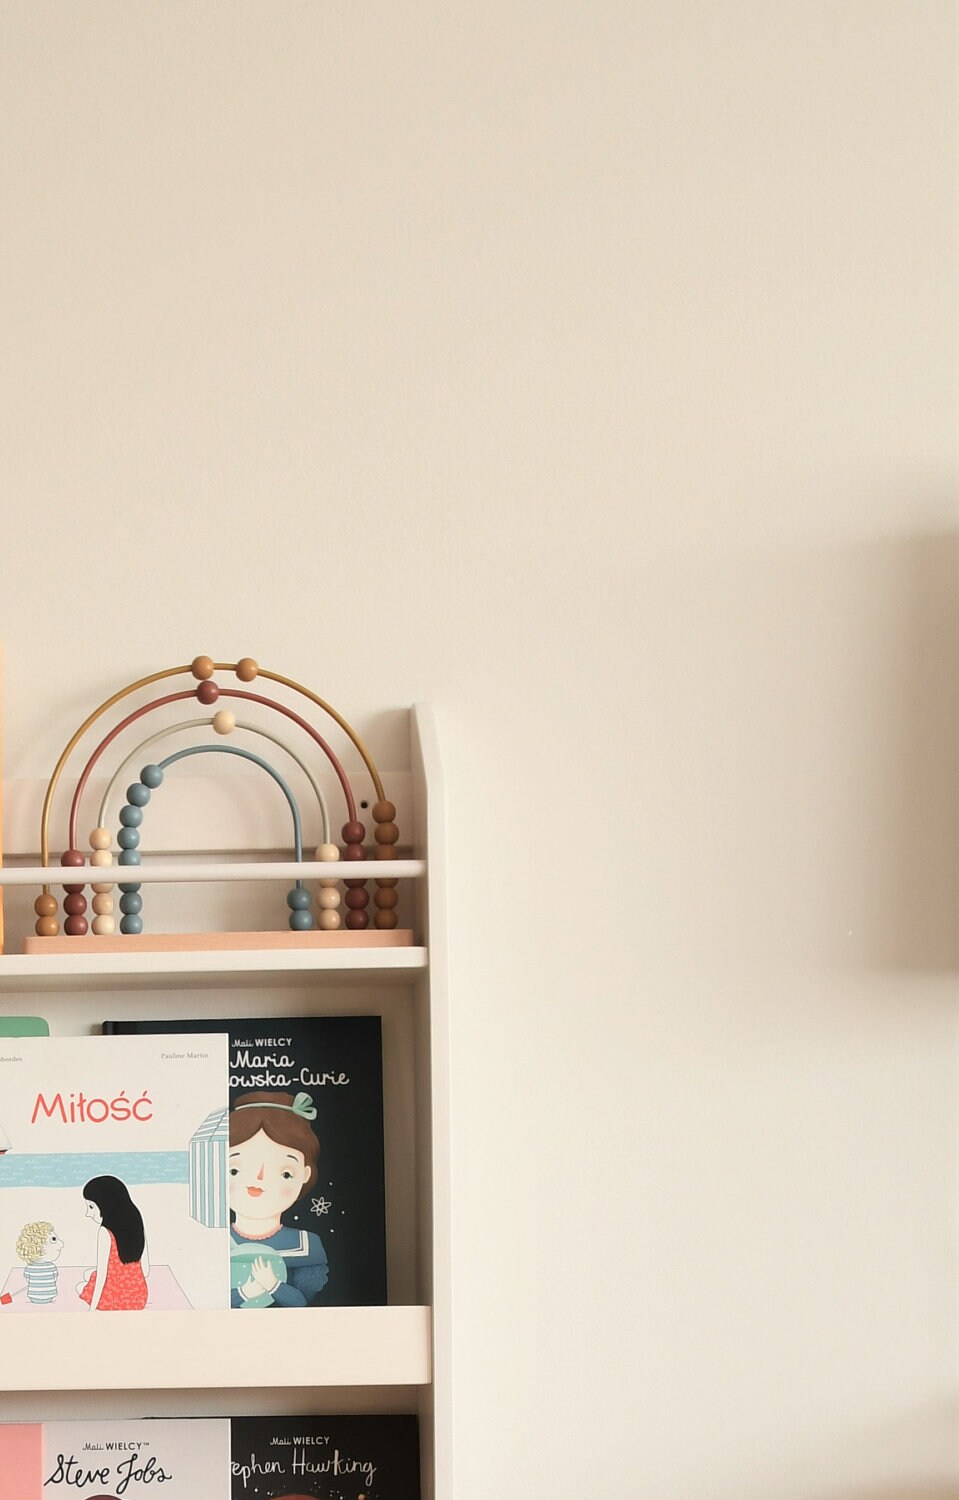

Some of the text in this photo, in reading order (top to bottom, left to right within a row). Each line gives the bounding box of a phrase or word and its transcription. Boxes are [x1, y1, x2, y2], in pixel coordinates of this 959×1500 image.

[231, 1038, 292, 1048] Mali WIELCY
[230, 1050, 295, 1068] Maria
[229, 1067, 350, 1088] owska-Curie
[31, 1090, 153, 1124] Miłość
[82, 1442, 104, 1451] Mali
[270, 1436, 330, 1446] Mali WIELCY
[43, 1453, 172, 1495] Steve Jobs
[231, 1447, 377, 1488] ephen Hawking
